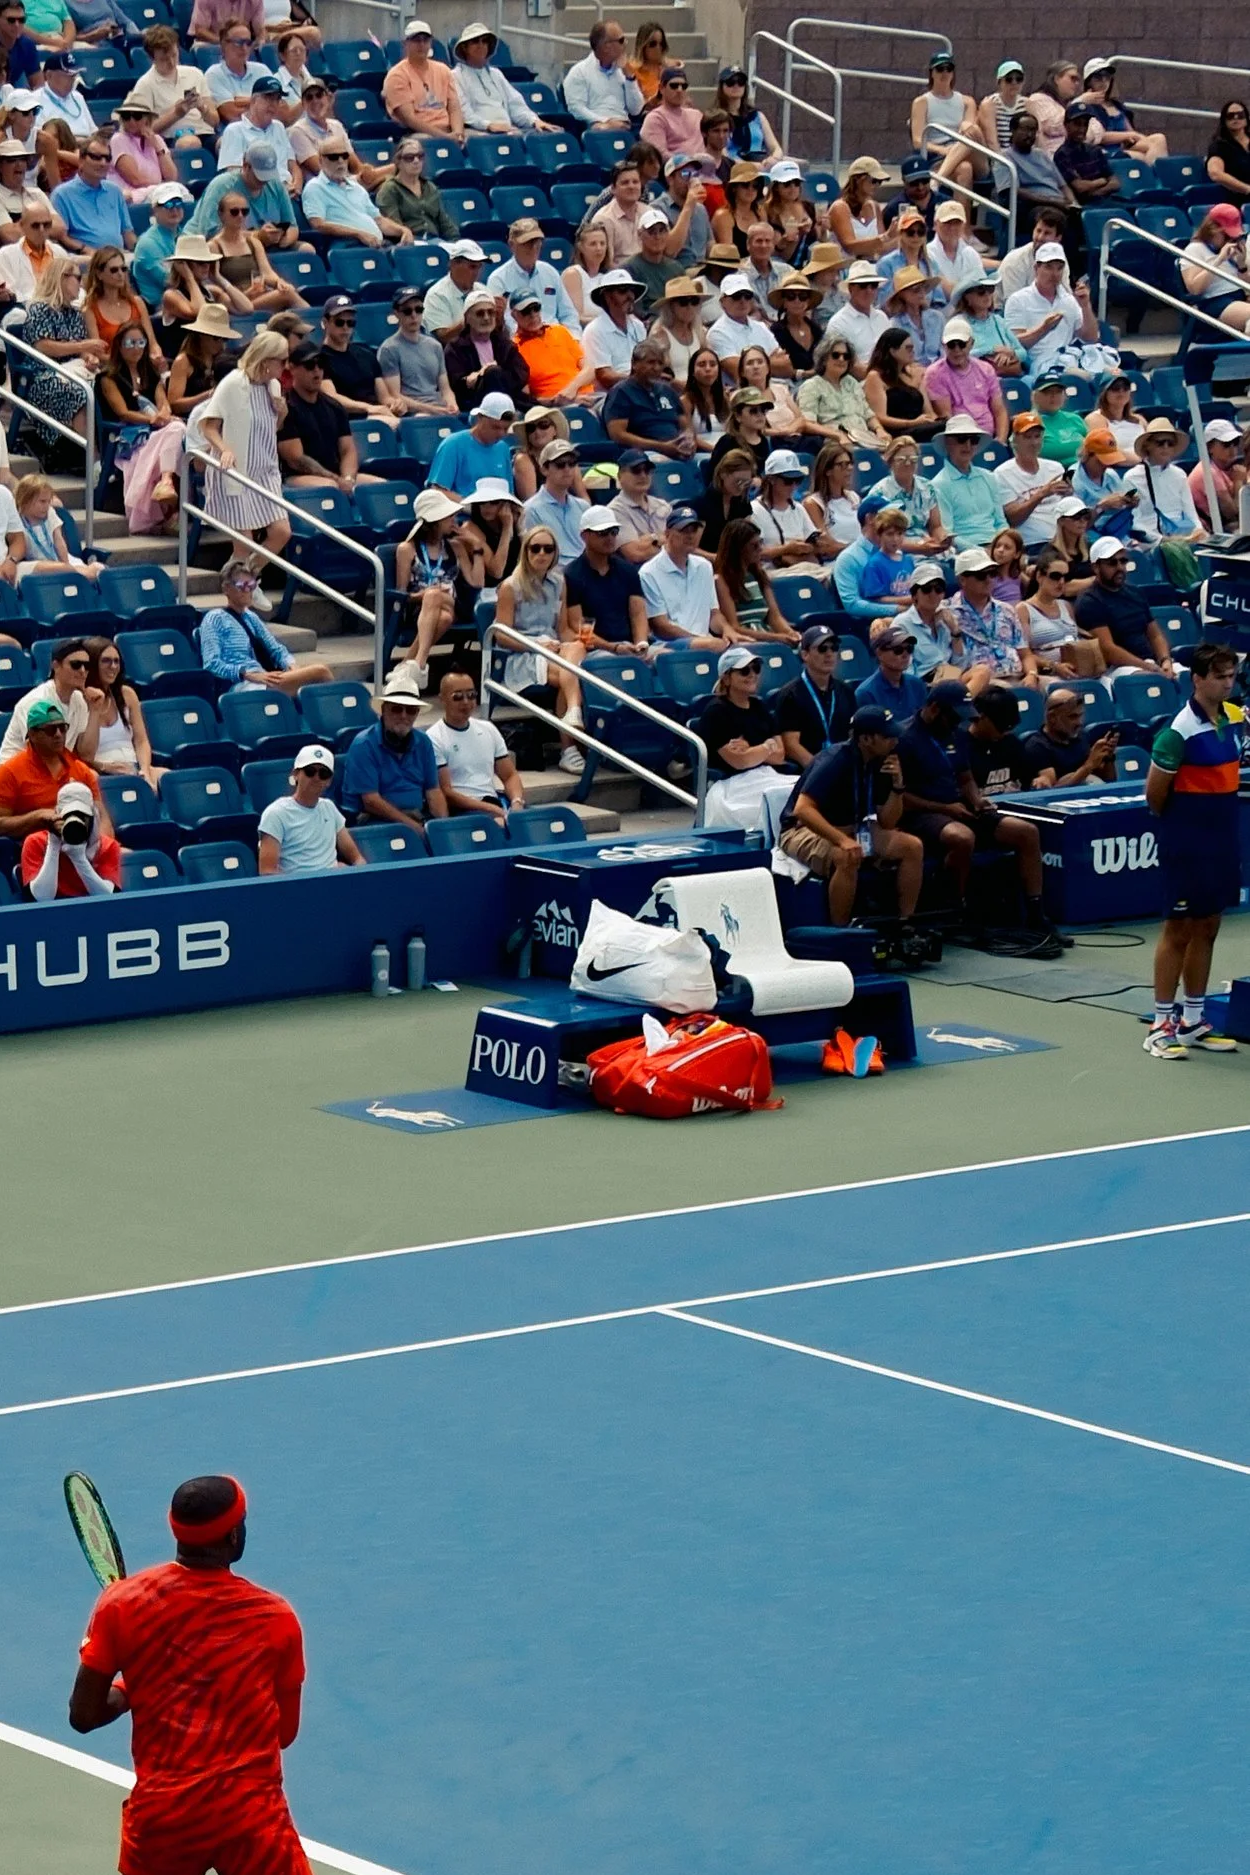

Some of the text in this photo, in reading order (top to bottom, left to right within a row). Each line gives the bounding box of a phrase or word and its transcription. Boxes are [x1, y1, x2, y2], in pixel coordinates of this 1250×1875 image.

[1091, 832, 1159, 875] Wil
[532, 918, 579, 949] evian
[472, 1033, 547, 1085] POLO
